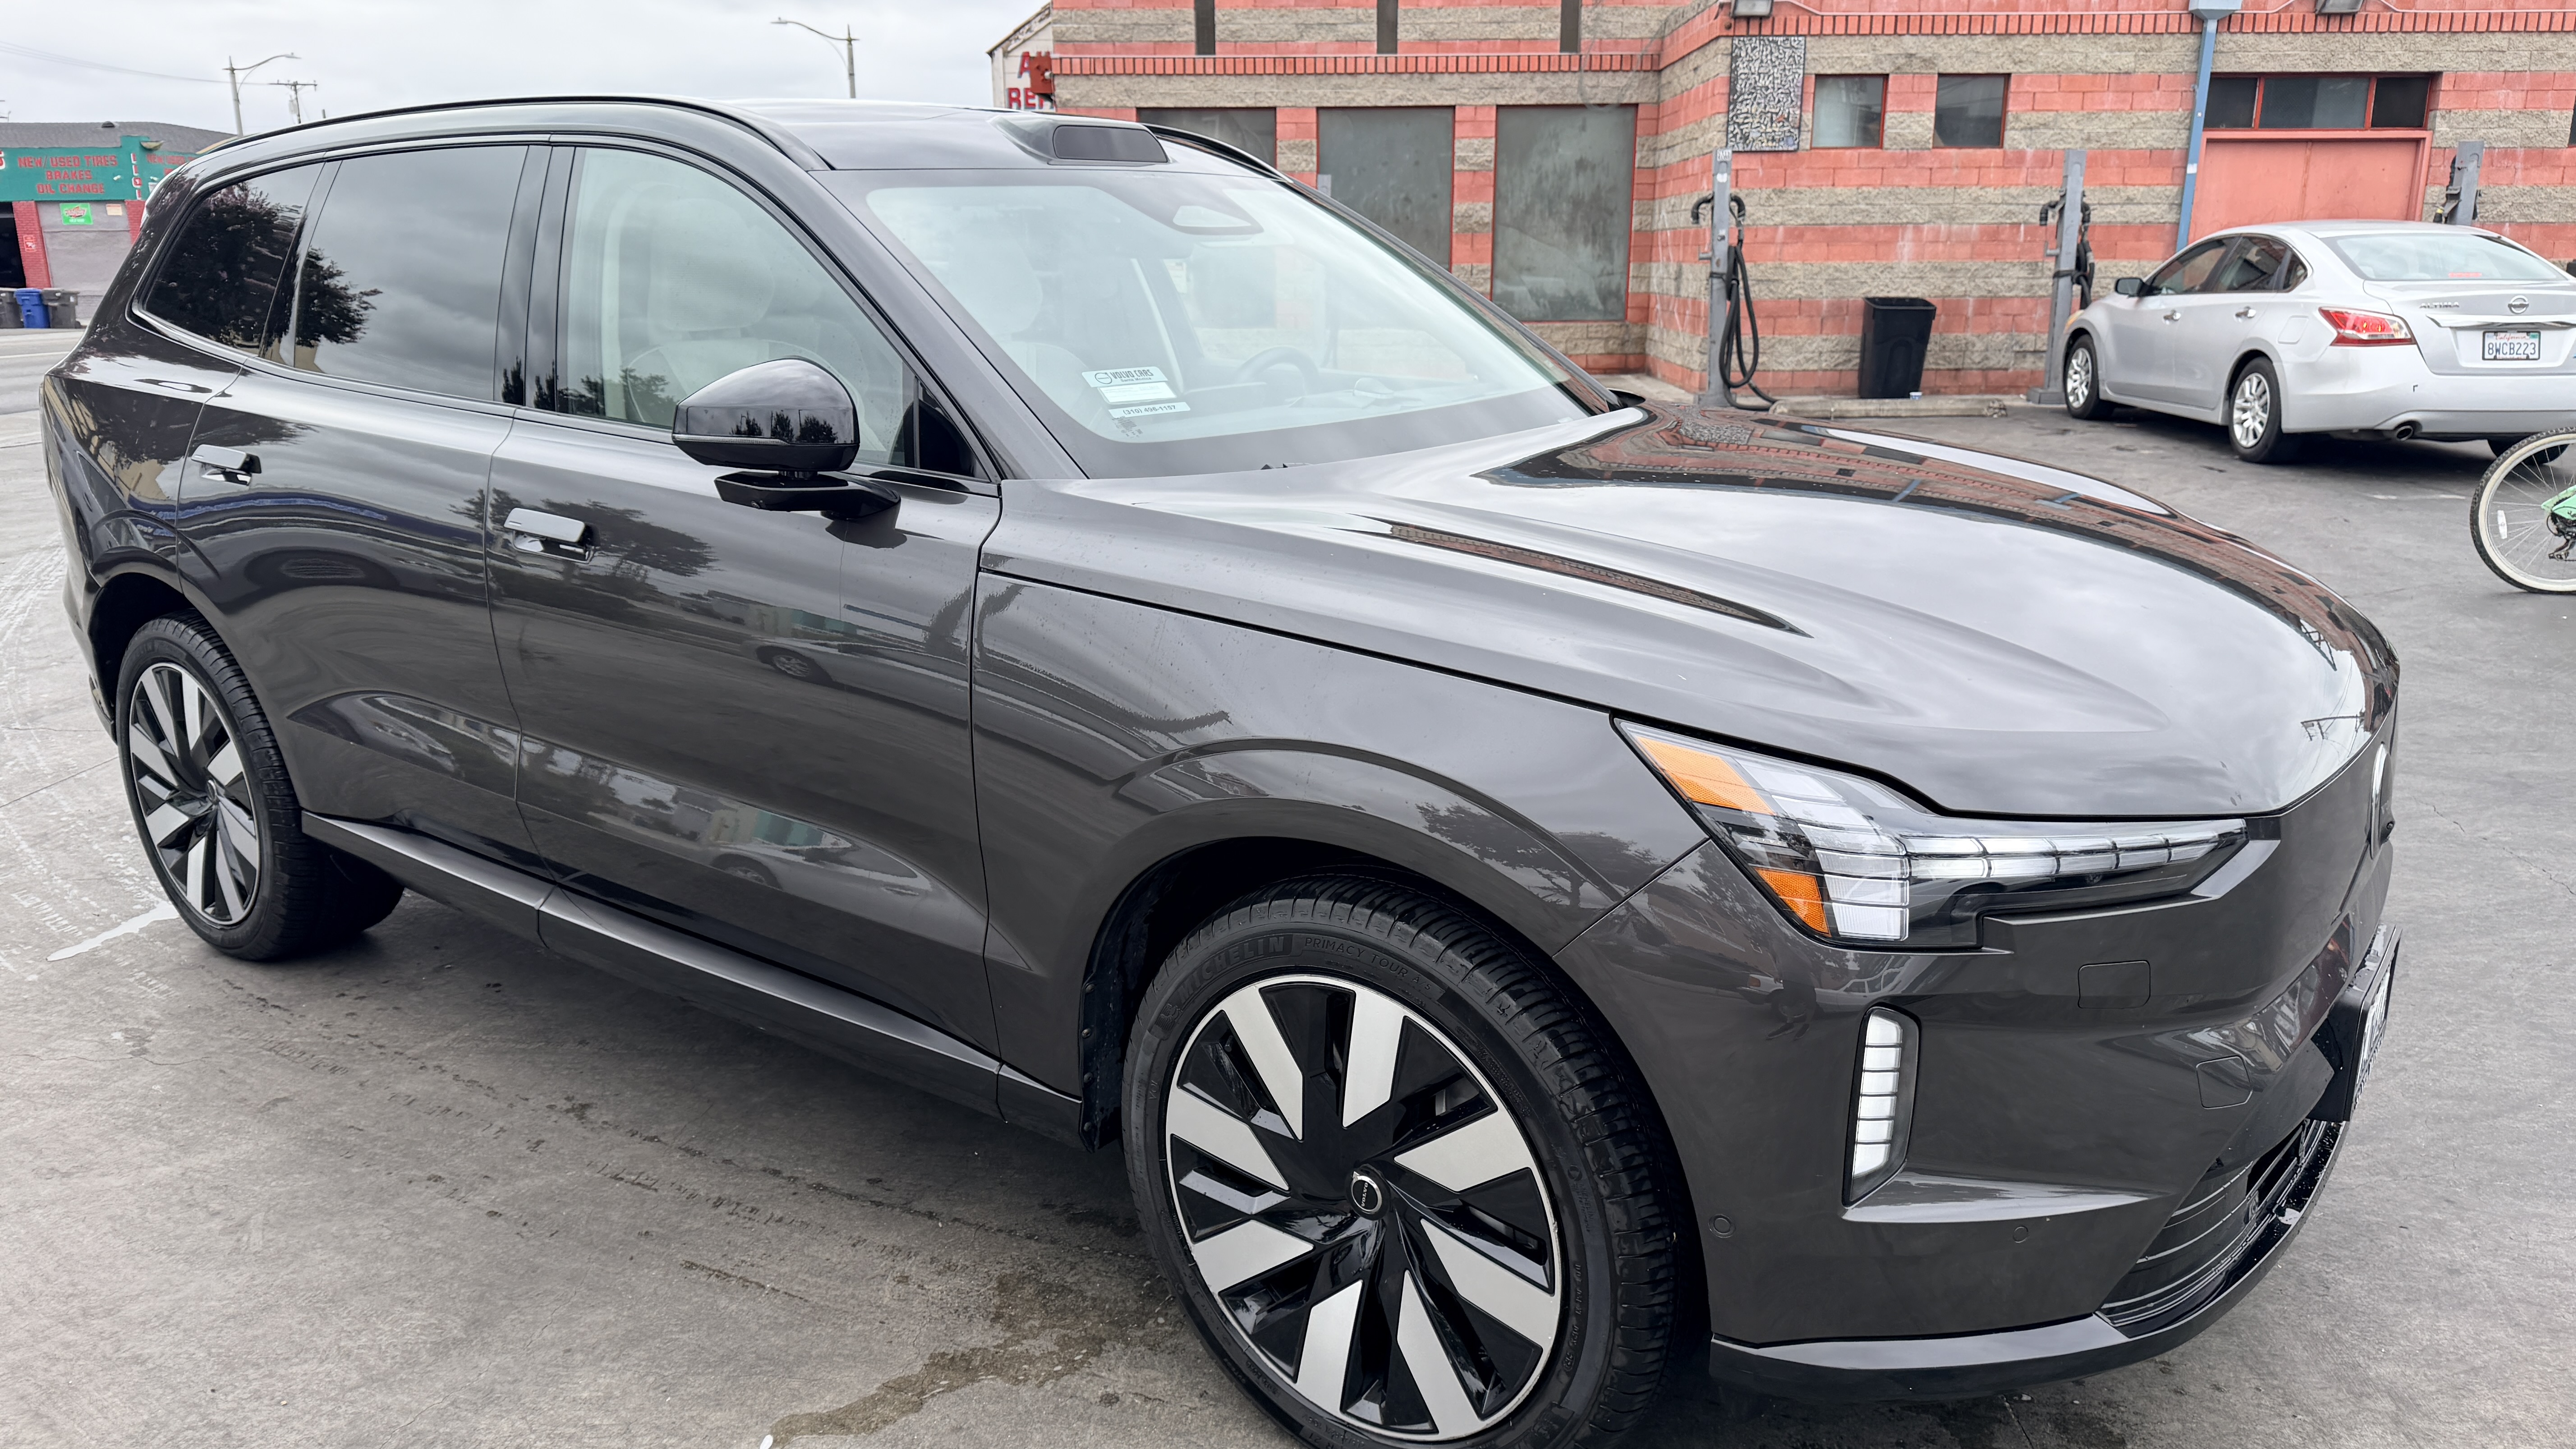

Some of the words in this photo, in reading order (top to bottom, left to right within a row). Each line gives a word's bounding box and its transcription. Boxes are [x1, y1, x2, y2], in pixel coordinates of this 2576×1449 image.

[50, 156, 81, 167] USED
[84, 155, 118, 166] TIRES
[46, 170, 92, 180] BRAKES
[37, 184, 55, 194] OIL
[59, 183, 105, 194] CHANGE
[2495, 333, 2526, 341] California
[2488, 342, 2536, 355] 8WCB223
[1109, 370, 1135, 379] VOLVO
[1133, 369, 1154, 377] CARS
[1305, 937, 1366, 958] PRIMACY
[1371, 954, 1408, 978] TOUR
[1412, 974, 1432, 990] A/S
[1178, 936, 1284, 1003] MICHELIN
